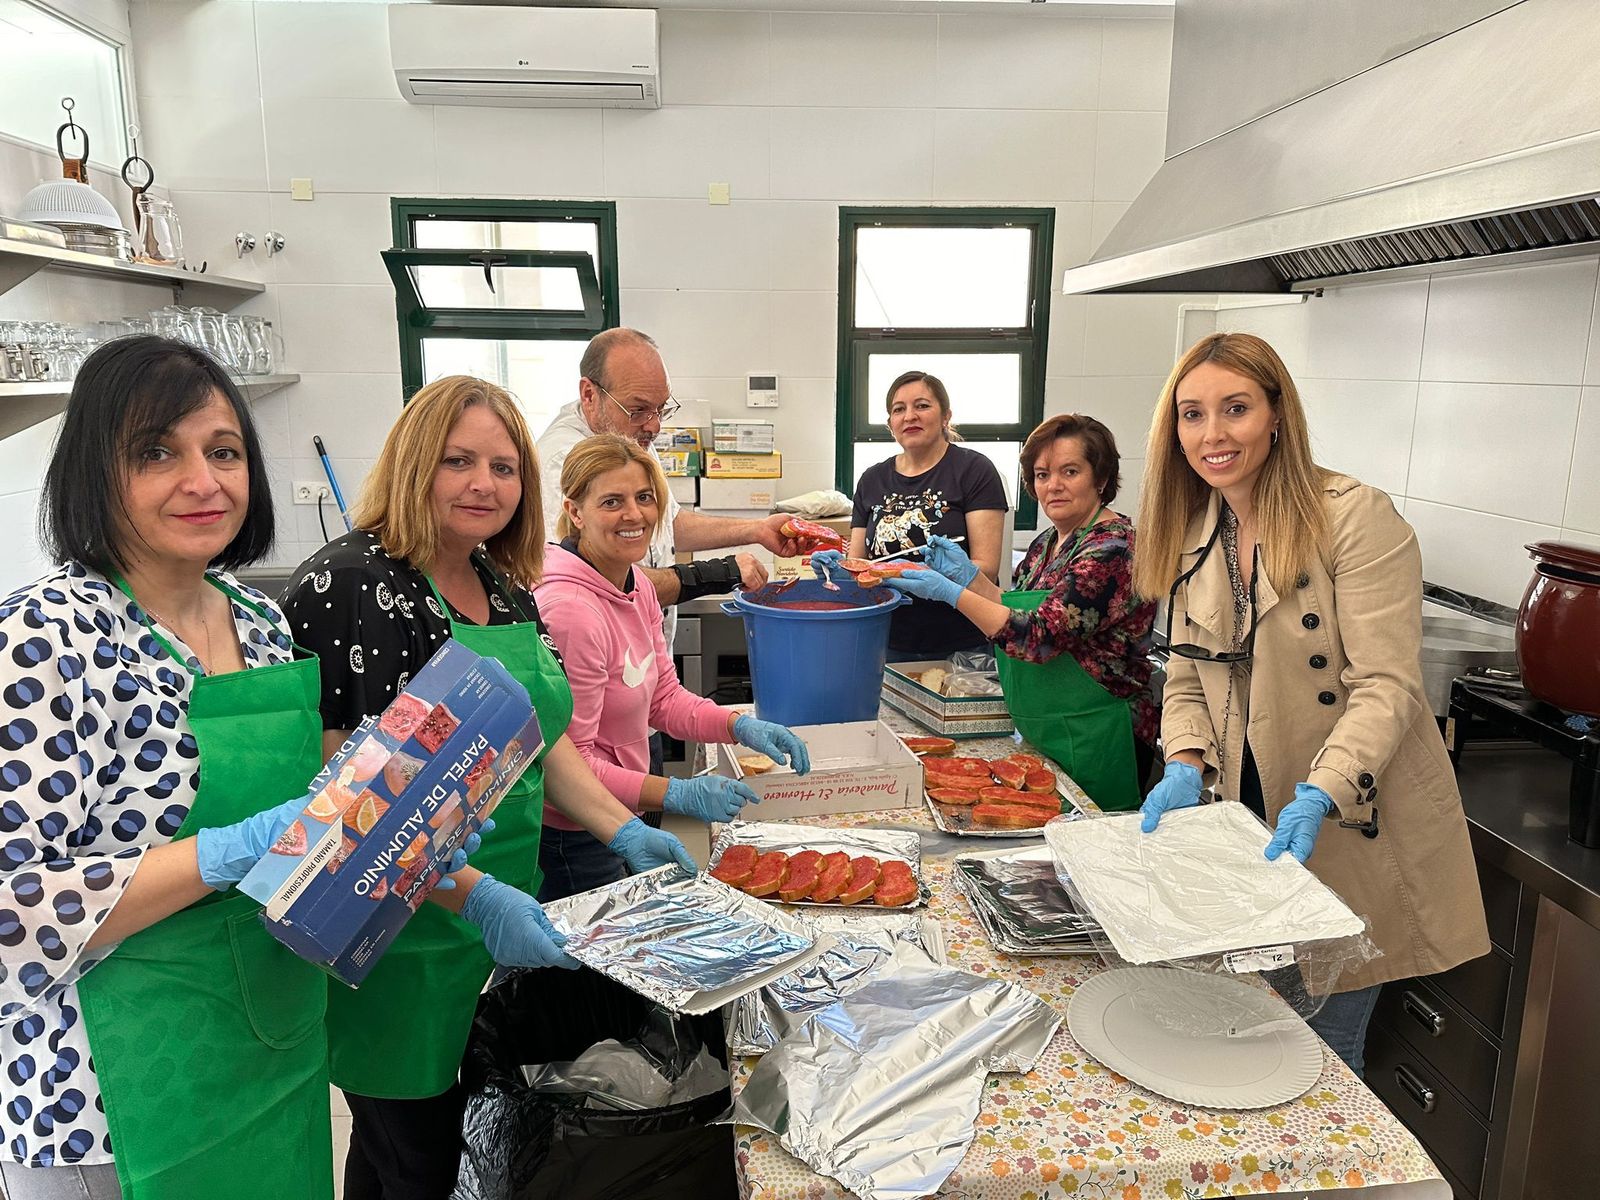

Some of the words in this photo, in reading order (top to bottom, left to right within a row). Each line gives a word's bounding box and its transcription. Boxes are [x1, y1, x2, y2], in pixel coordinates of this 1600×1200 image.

[331, 740, 356, 763] DE
[442, 733, 489, 782] PAPEL
[422, 784, 447, 812] DE
[764, 789, 815, 801] Hornero
[818, 788, 834, 800] El
[403, 852, 445, 902] PAPEL
[445, 824, 464, 849] DE
[466, 750, 524, 825] ALUMINIO
[354, 808, 424, 896] ALUMINIO
[280, 861, 317, 902] PROFESIONAL
